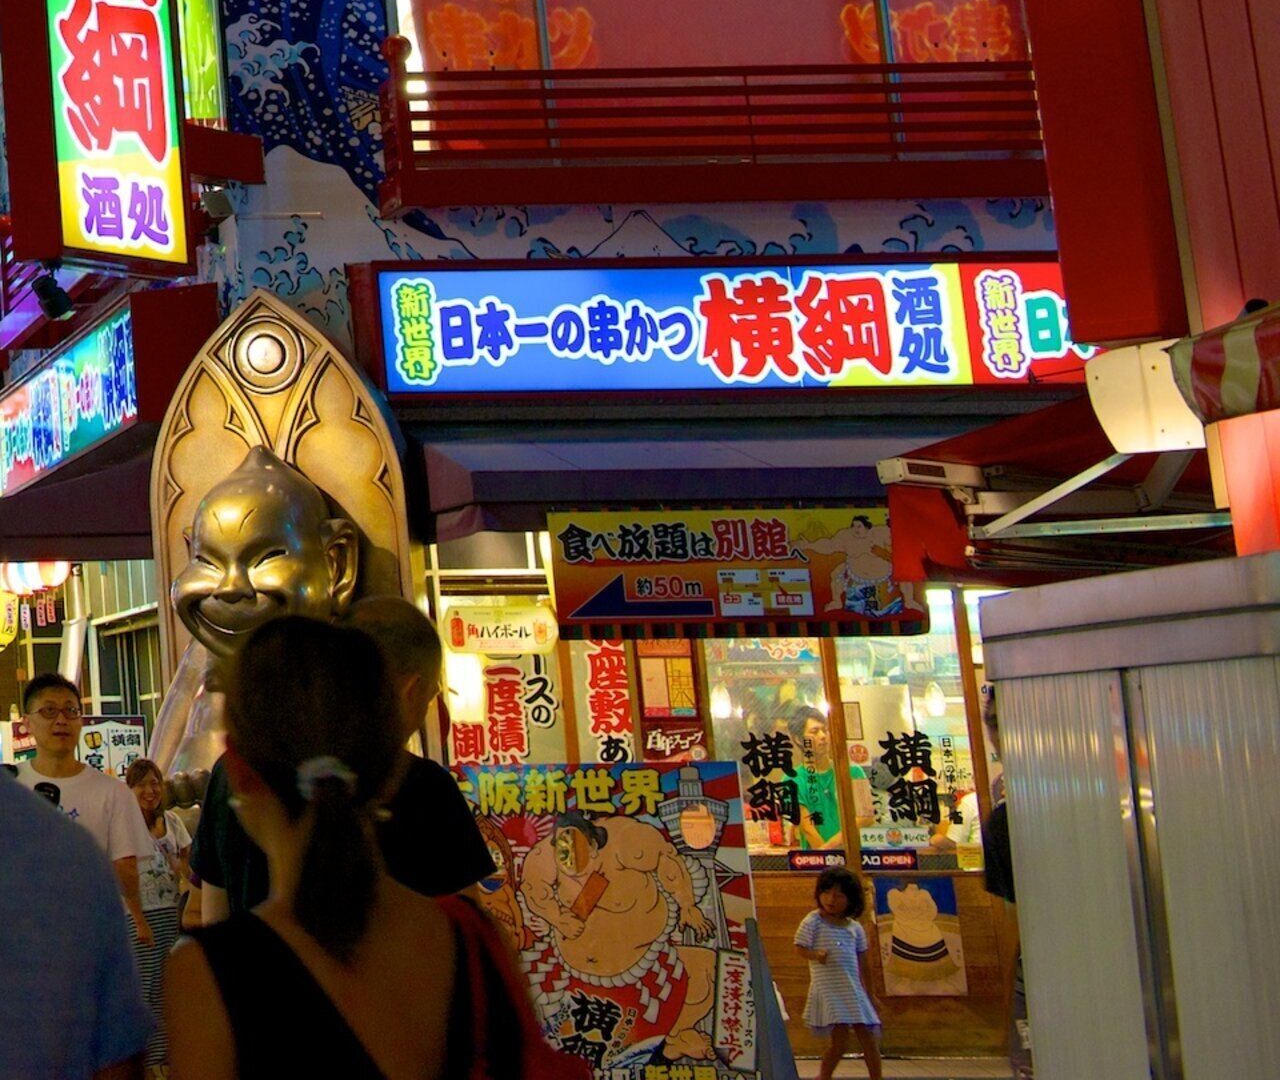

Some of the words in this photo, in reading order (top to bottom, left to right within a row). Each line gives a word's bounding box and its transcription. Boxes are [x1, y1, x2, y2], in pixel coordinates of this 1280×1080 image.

[81, 171, 170, 244] 酒処
[398, 283, 433, 382] 新世界
[440, 296, 694, 362] 日本一の串かつ
[699, 276, 891, 379] 横綱
[893, 276, 950, 376] 酒処
[983, 276, 1026, 377] 新世界
[558, 518, 808, 562] 食べ放題は別館へ
[636, 577, 702, 597] 約50m
[467, 623, 532, 639] 角ハイボール
[111, 734, 141, 747] 横綱
[484, 666, 526, 766] 二度漬
[741, 731, 801, 825] 横綱
[878, 731, 940, 825] 横綱
[795, 855, 824, 865] OPEN
[882, 855, 912, 865] OPEN
